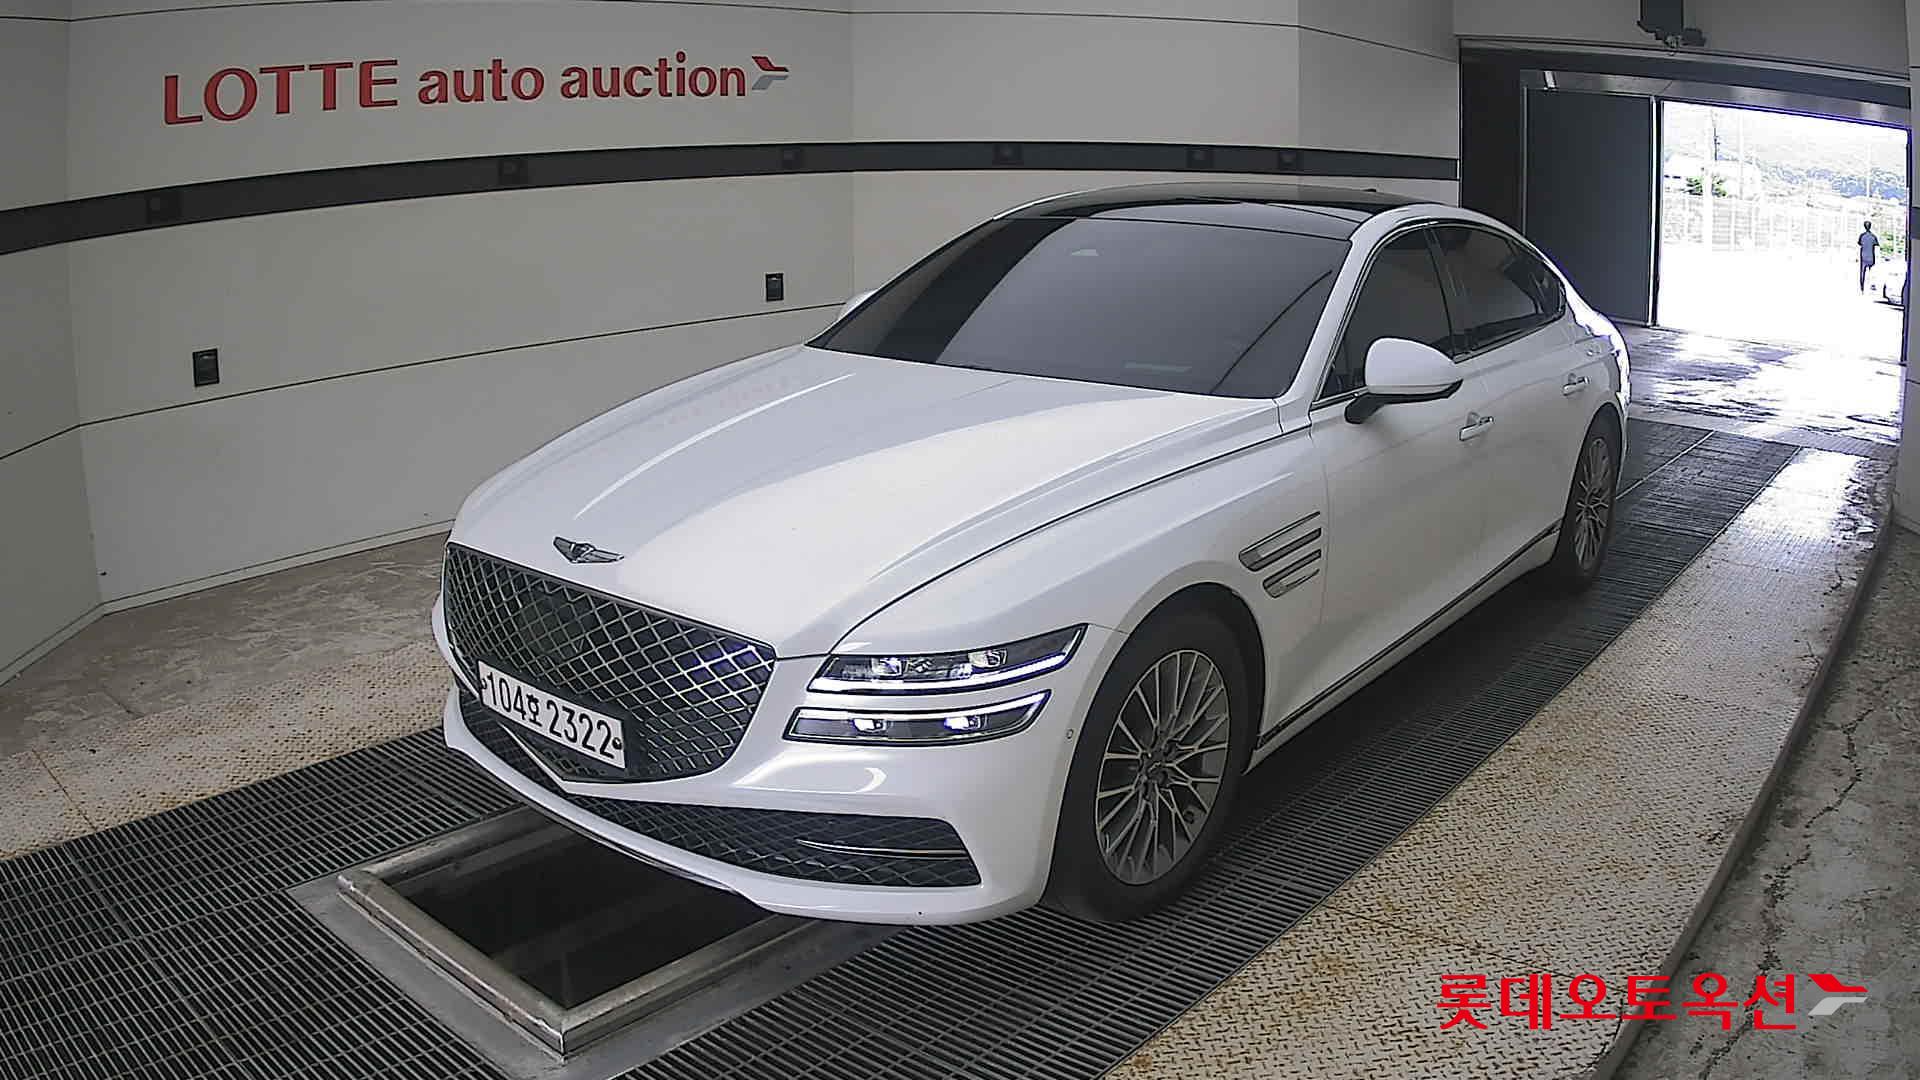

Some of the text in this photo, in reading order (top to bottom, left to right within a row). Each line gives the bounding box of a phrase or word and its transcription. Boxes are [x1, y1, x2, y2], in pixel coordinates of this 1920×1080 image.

[163, 51, 747, 125] LOTTE auto auction
[487, 672, 614, 759] 104호 2322
